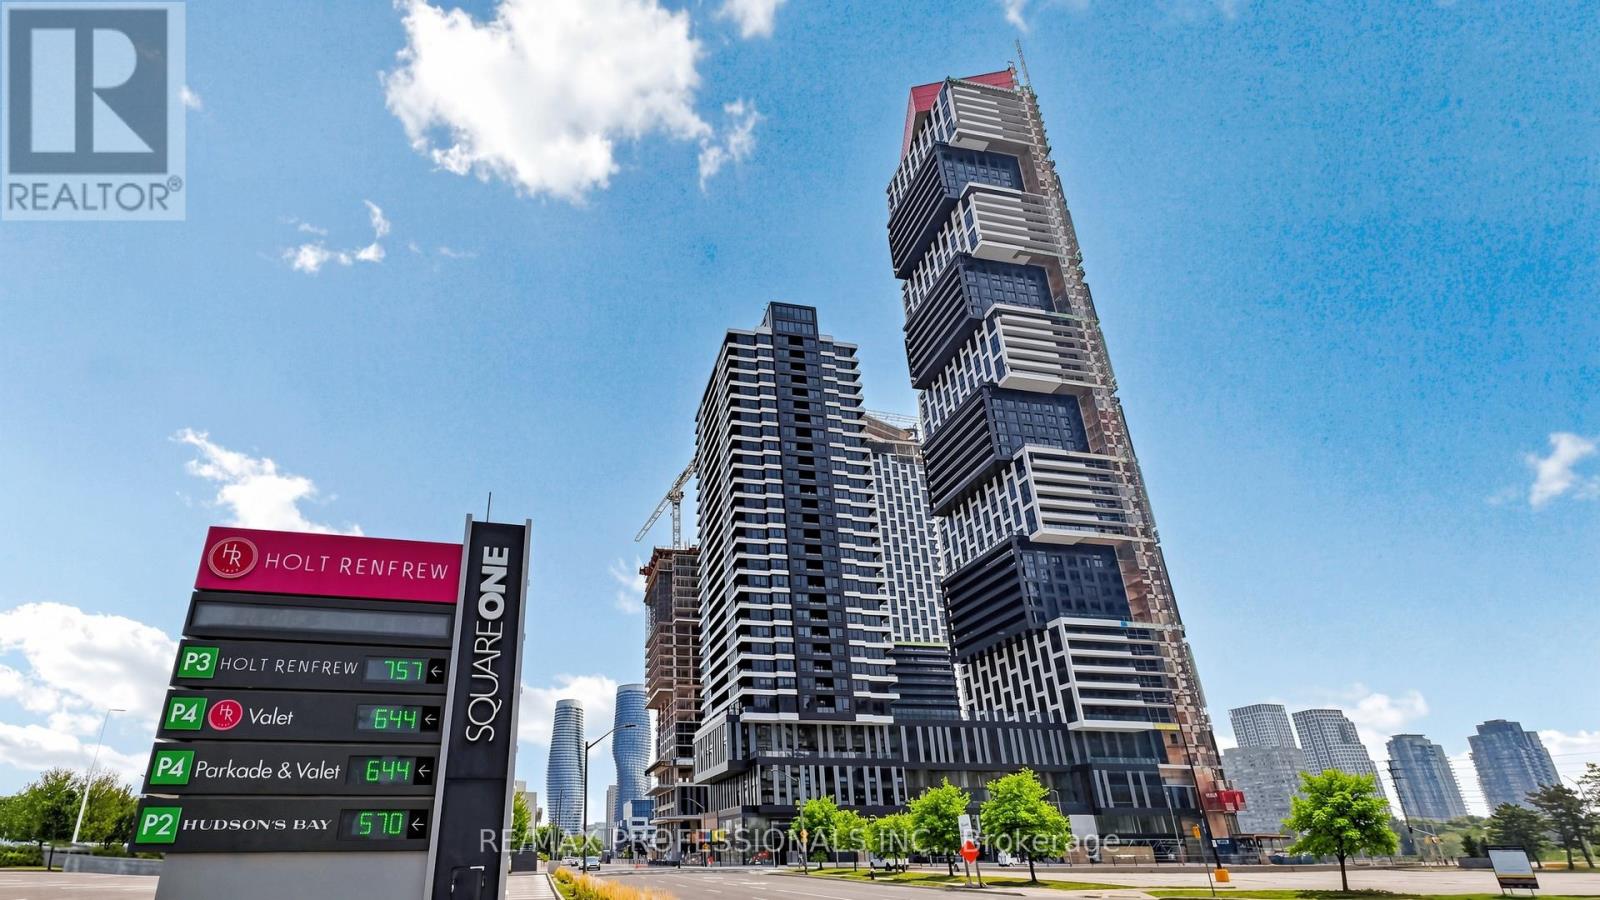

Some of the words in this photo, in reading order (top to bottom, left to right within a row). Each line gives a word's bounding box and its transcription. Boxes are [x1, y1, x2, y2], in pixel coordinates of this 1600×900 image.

[265, 553, 330, 572] HOLT
[339, 557, 448, 580] RENFREW
[183, 652, 211, 671] P3
[220, 657, 268, 672] HOLT
[274, 659, 359, 676] RENFREW
[384, 660, 423, 680] 757
[170, 703, 198, 723] P4
[249, 706, 294, 725] Valet
[374, 708, 417, 729] 644
[156, 757, 184, 778] P4
[194, 760, 273, 779] Parkade
[277, 761, 292, 779] &
[297, 760, 341, 780] Valet
[366, 760, 410, 782] 644
[141, 814, 174, 836] P2
[182, 819, 287, 831] HUDSON'S
[293, 820, 332, 831] BAY
[359, 812, 403, 835] 570
